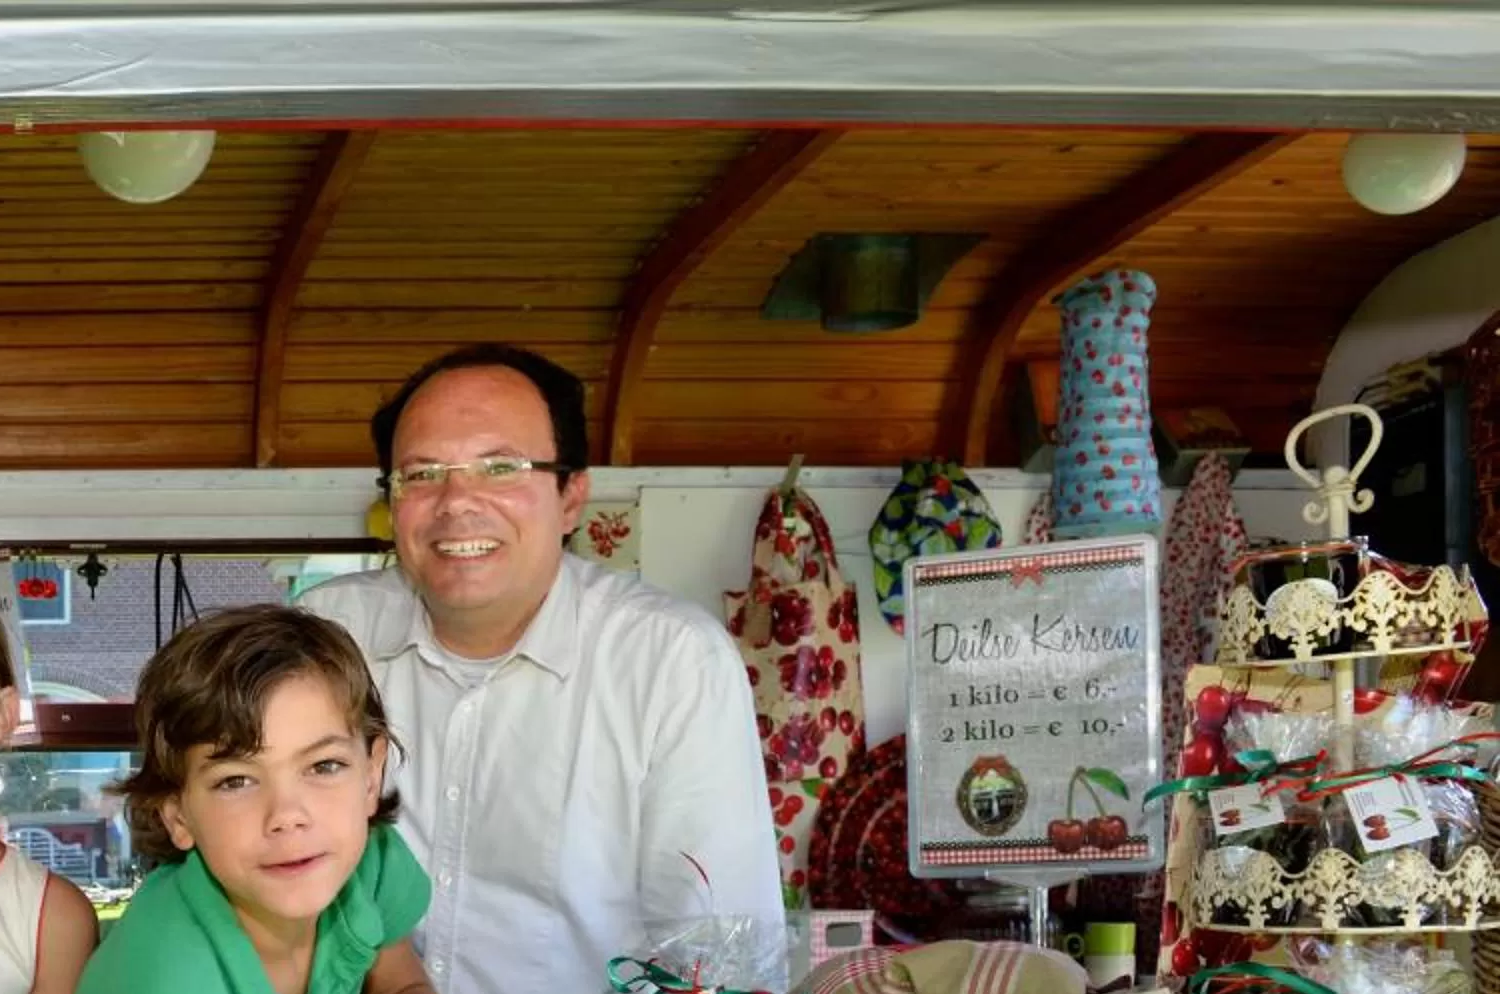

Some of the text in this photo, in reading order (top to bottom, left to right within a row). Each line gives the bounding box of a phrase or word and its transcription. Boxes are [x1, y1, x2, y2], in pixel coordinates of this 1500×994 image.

[921, 613, 1140, 665] Deilse Kersen
[949, 692, 960, 708] 1
[968, 684, 1020, 708] kilo
[940, 728, 955, 744] 2
[964, 718, 1015, 742] kilo
